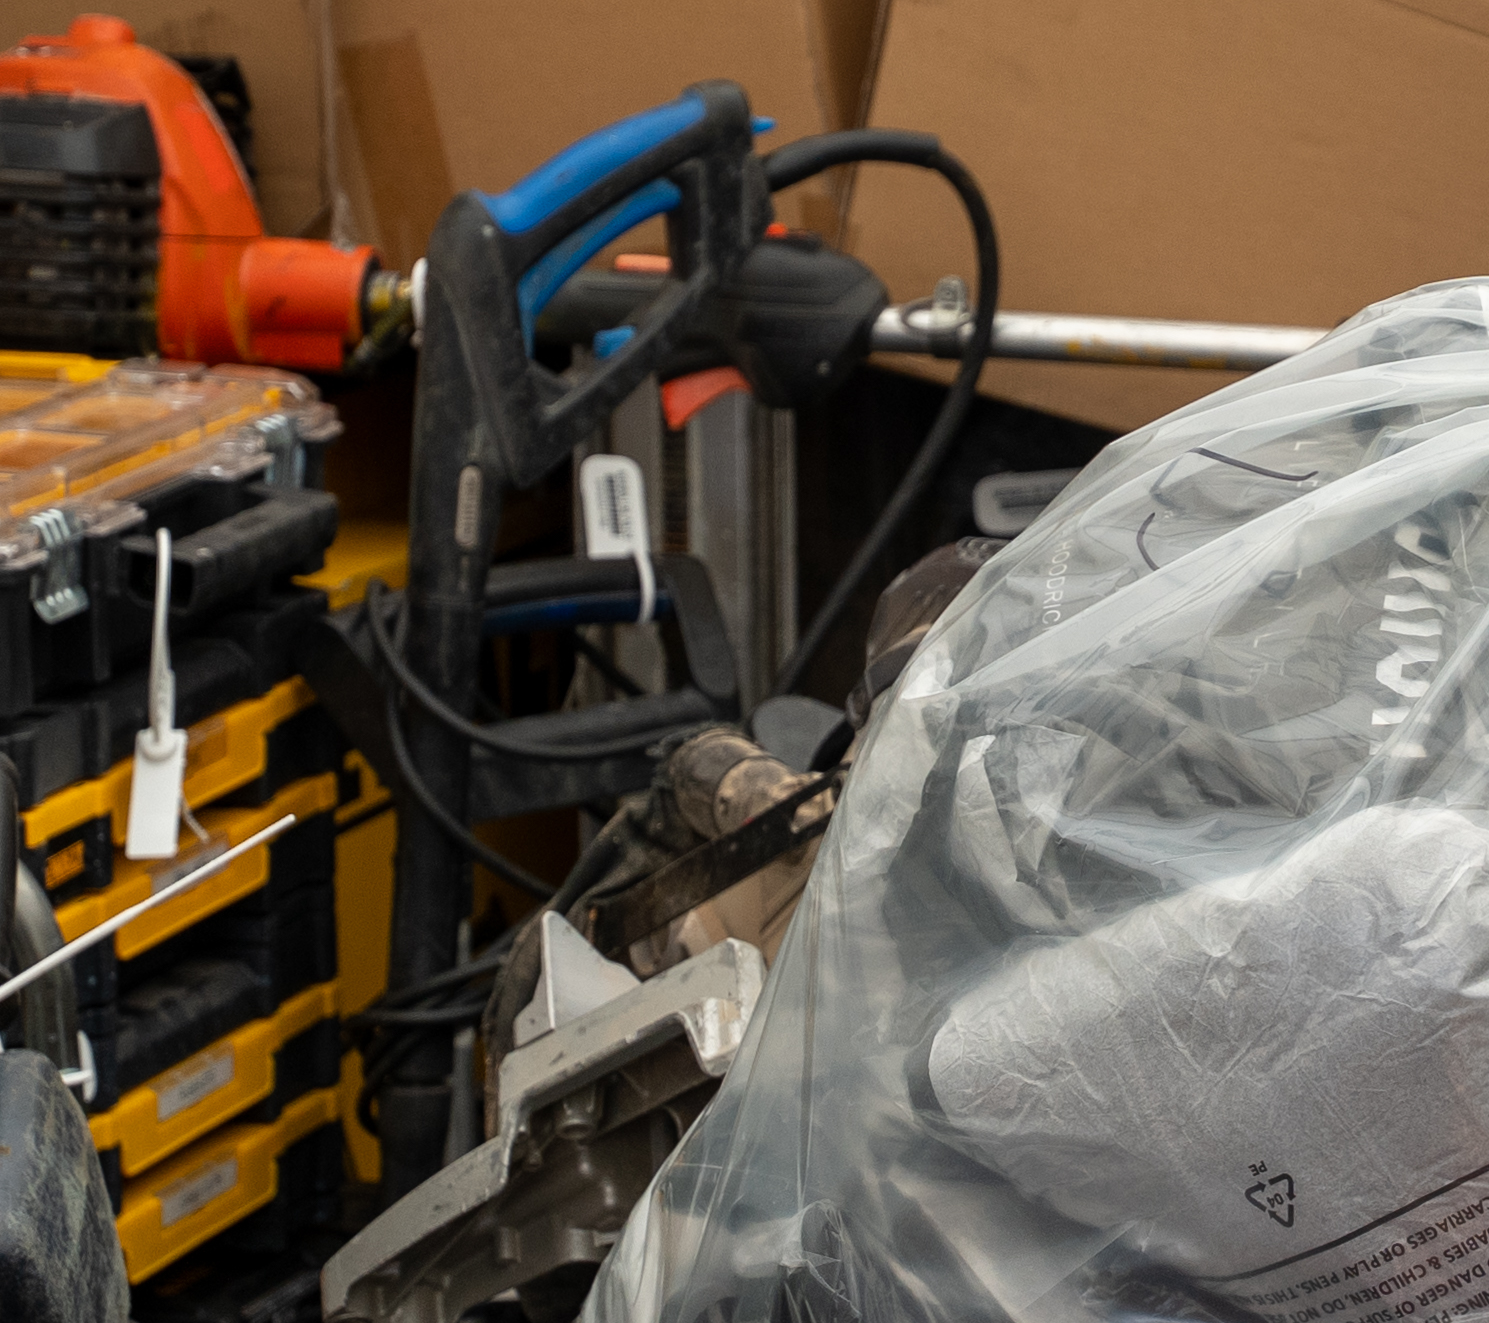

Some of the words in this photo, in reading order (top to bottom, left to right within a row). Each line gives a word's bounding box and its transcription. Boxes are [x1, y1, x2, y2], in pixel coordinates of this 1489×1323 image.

[1248, 1160, 1269, 1177] PE
[1377, 1240, 1407, 1263] OR
[1425, 1254, 1442, 1272] &
[1338, 1252, 1382, 1282] PLAY
[1293, 1267, 1340, 1298] PENS.
[1342, 1261, 1429, 1310] CHILDREN,
[1412, 1260, 1487, 1307] DANGER
[1262, 1282, 1296, 1308] THIS
[1319, 1296, 1346, 1318] DO
[1389, 1297, 1416, 1319] OF
